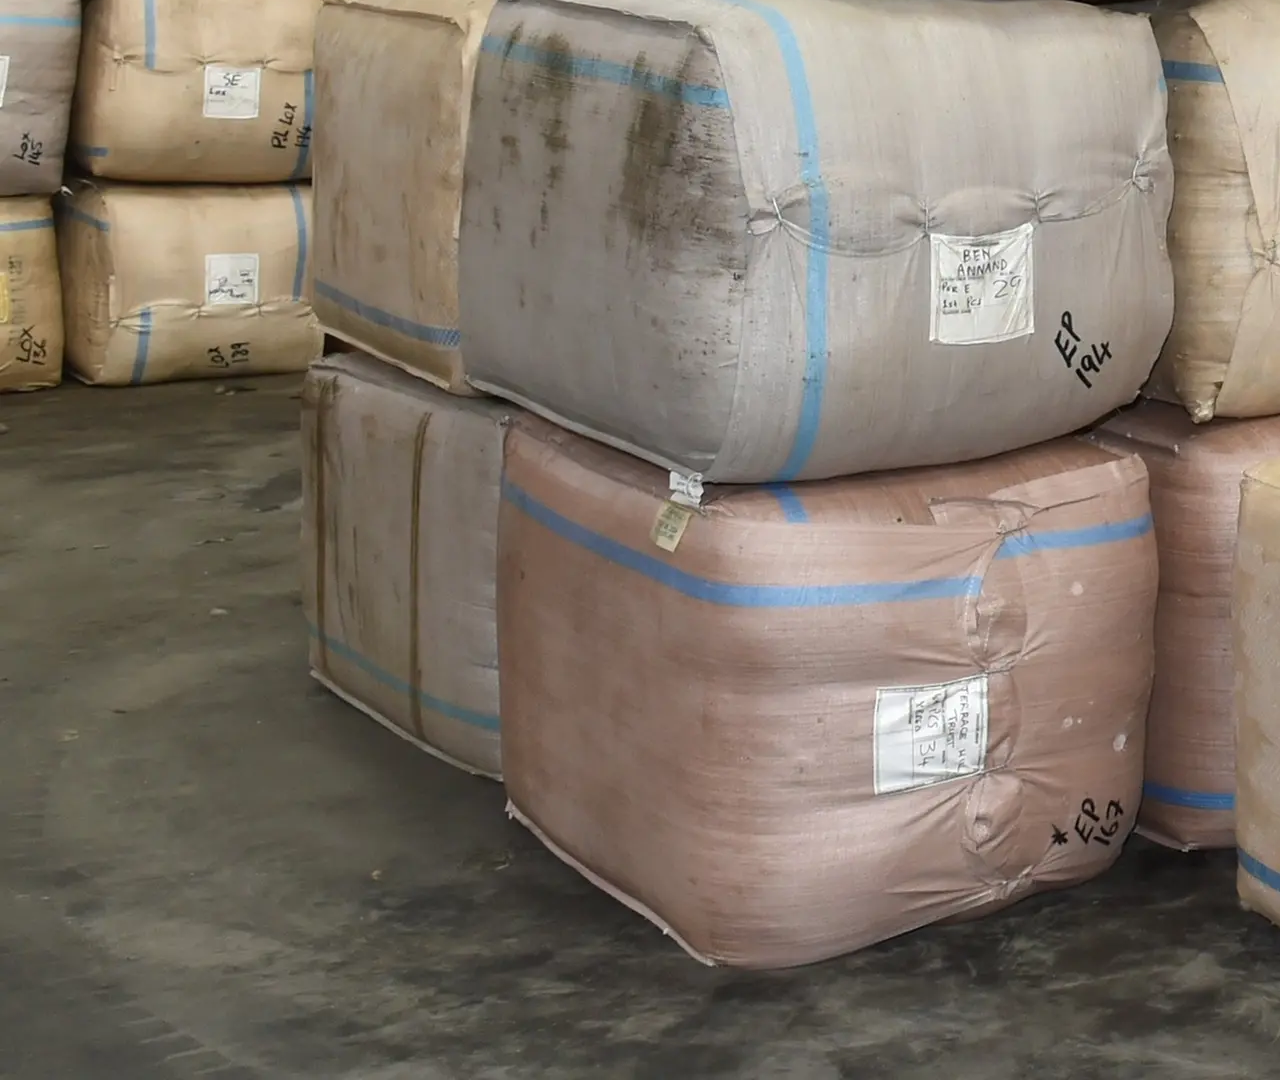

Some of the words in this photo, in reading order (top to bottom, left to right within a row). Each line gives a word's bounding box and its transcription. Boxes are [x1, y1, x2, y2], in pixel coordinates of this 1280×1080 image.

[957, 259, 1007, 277] ANNAND
[962, 249, 990, 263] BEN
[1054, 311, 1081, 368] EP
[1075, 341, 1112, 389] 194
[1074, 798, 1100, 845] EP
[1093, 798, 1124, 846] 167
